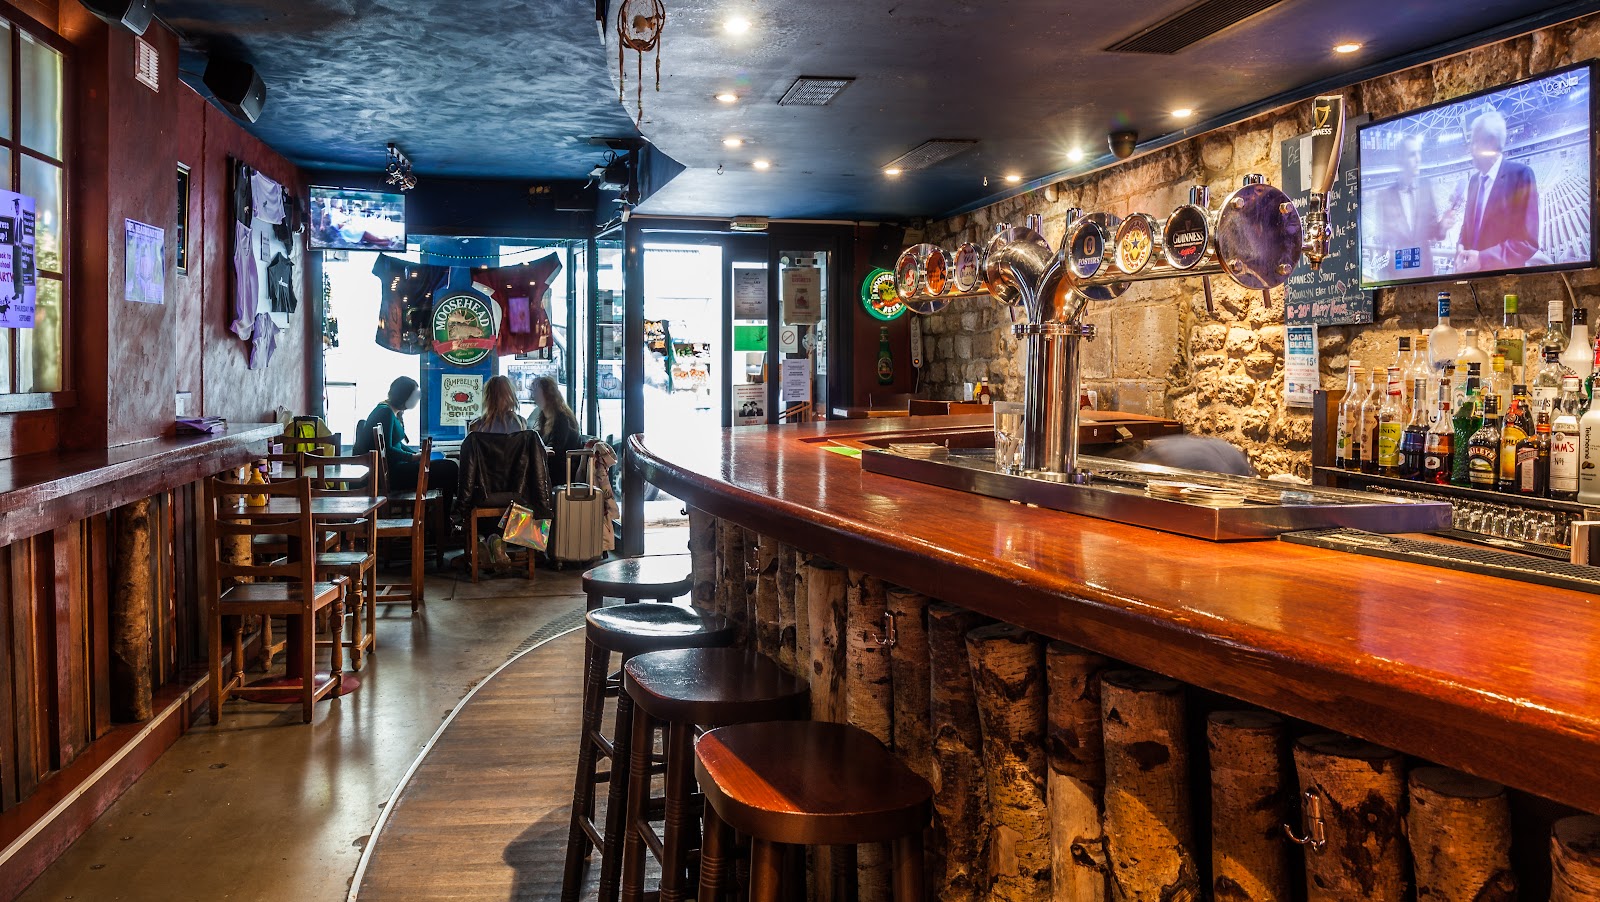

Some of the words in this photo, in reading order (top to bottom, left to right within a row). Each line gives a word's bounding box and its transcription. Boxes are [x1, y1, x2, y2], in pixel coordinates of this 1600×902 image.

[1173, 232, 1204, 244] GUINNESS
[0, 272, 14, 283] ARTY
[883, 303, 901, 314] BEER
[436, 298, 490, 331] MOOSEHEAD
[1289, 333, 1312, 341] CARTE
[1289, 341, 1313, 349] BLEUE
[444, 378, 479, 390] CAMPBELL'S
[445, 401, 479, 412] TOMATO
[1469, 446, 1497, 460] AILEYS
